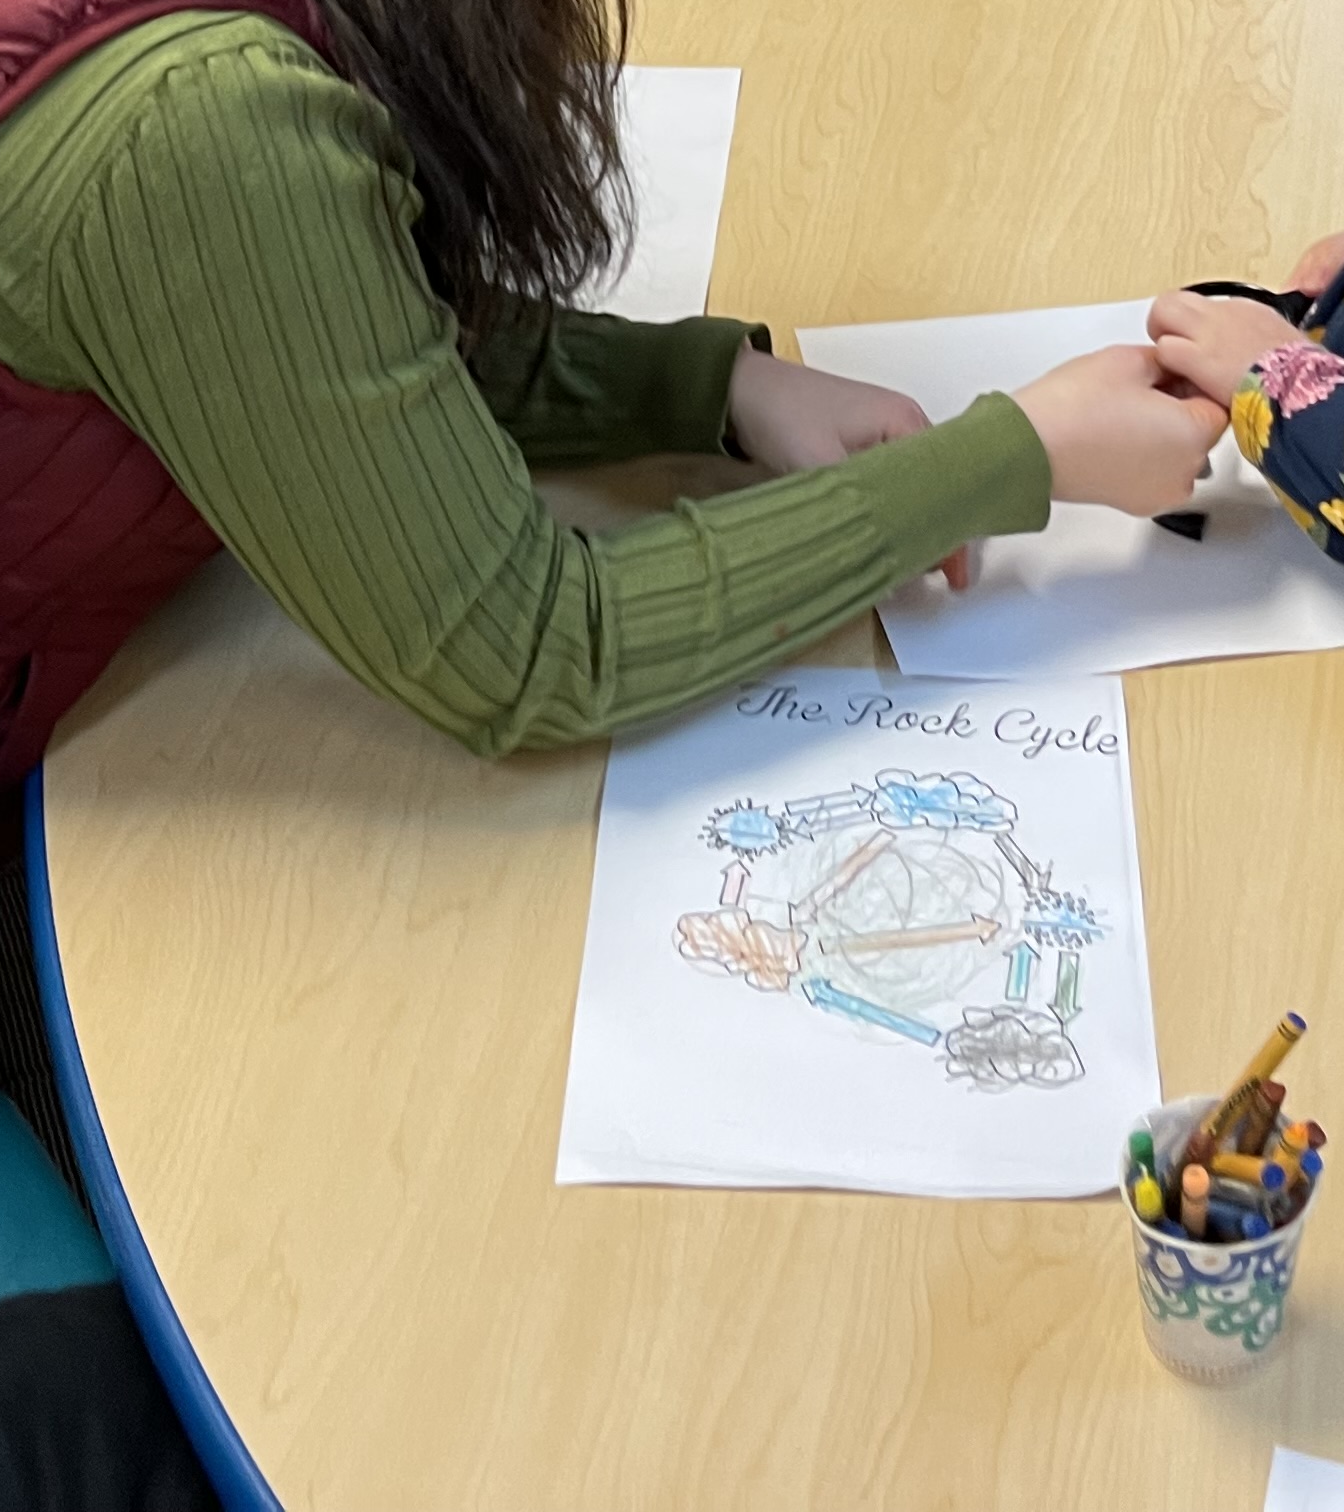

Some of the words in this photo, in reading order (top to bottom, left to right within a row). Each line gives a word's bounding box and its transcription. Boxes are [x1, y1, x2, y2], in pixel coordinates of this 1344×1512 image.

[736, 684, 829, 724] The
[844, 694, 978, 738] Rock
[993, 708, 1119, 760] Cycle
